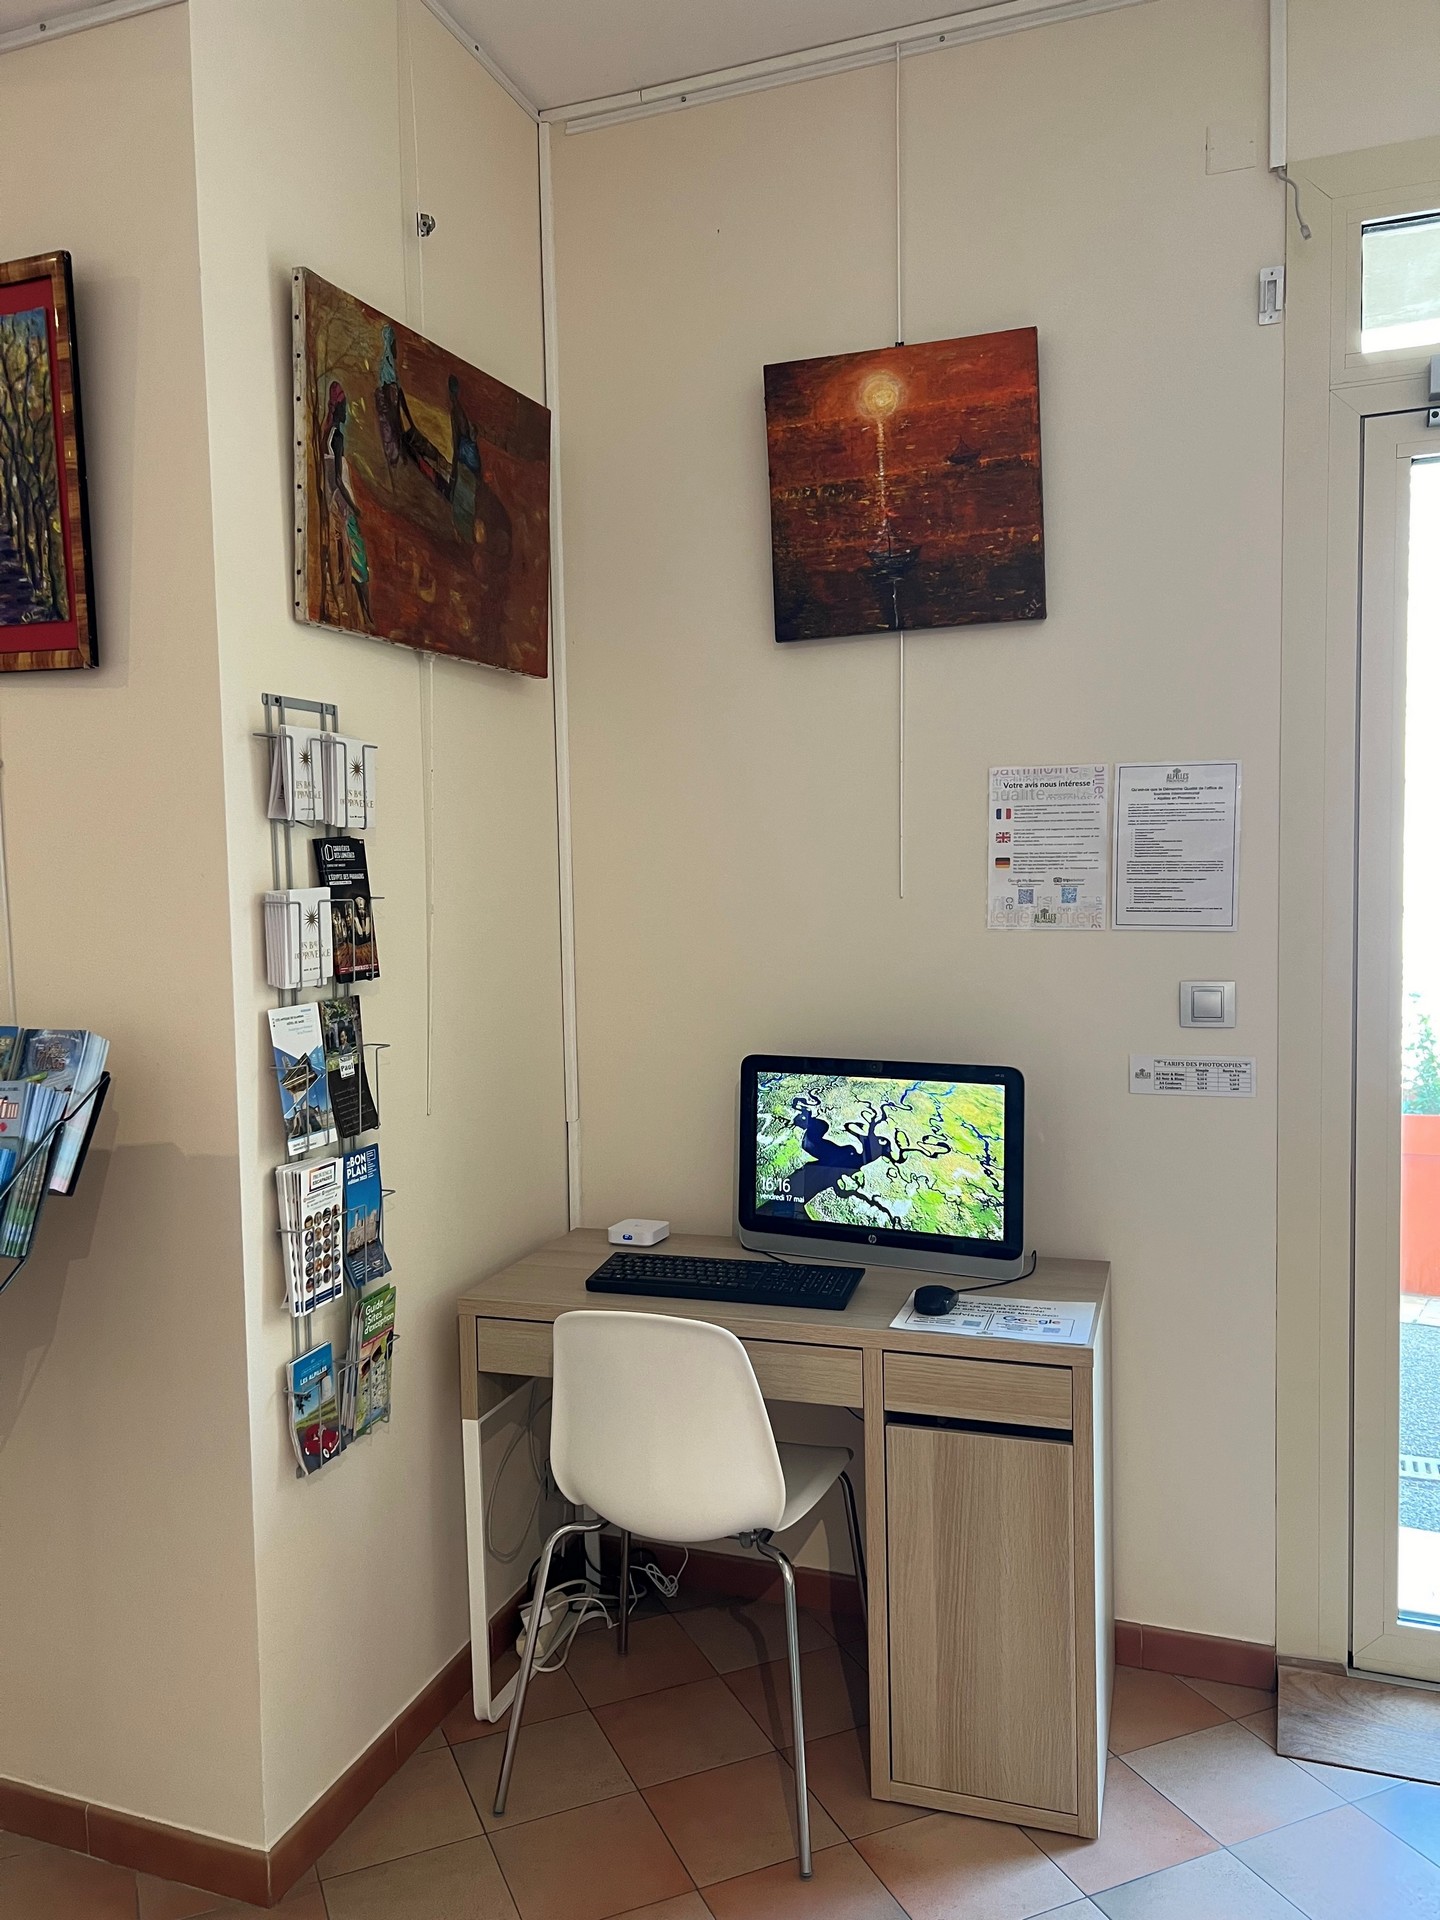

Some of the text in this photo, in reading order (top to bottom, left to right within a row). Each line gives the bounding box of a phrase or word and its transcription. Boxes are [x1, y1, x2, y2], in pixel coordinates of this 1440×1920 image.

[1058, 779, 1091, 787] intéresse
[341, 1062, 354, 1072] Paul
[350, 1153, 367, 1167] BON
[346, 1163, 367, 1180] PLAN
[760, 1193, 785, 1201] vendredi
[786, 1194, 792, 1202] 17
[366, 1300, 384, 1316] Guide
[364, 1312, 395, 1335] d'exception
[367, 1311, 383, 1325] Sites
[1003, 1315, 1061, 1325] Google
[300, 1366, 328, 1386] LES ALPILLES
